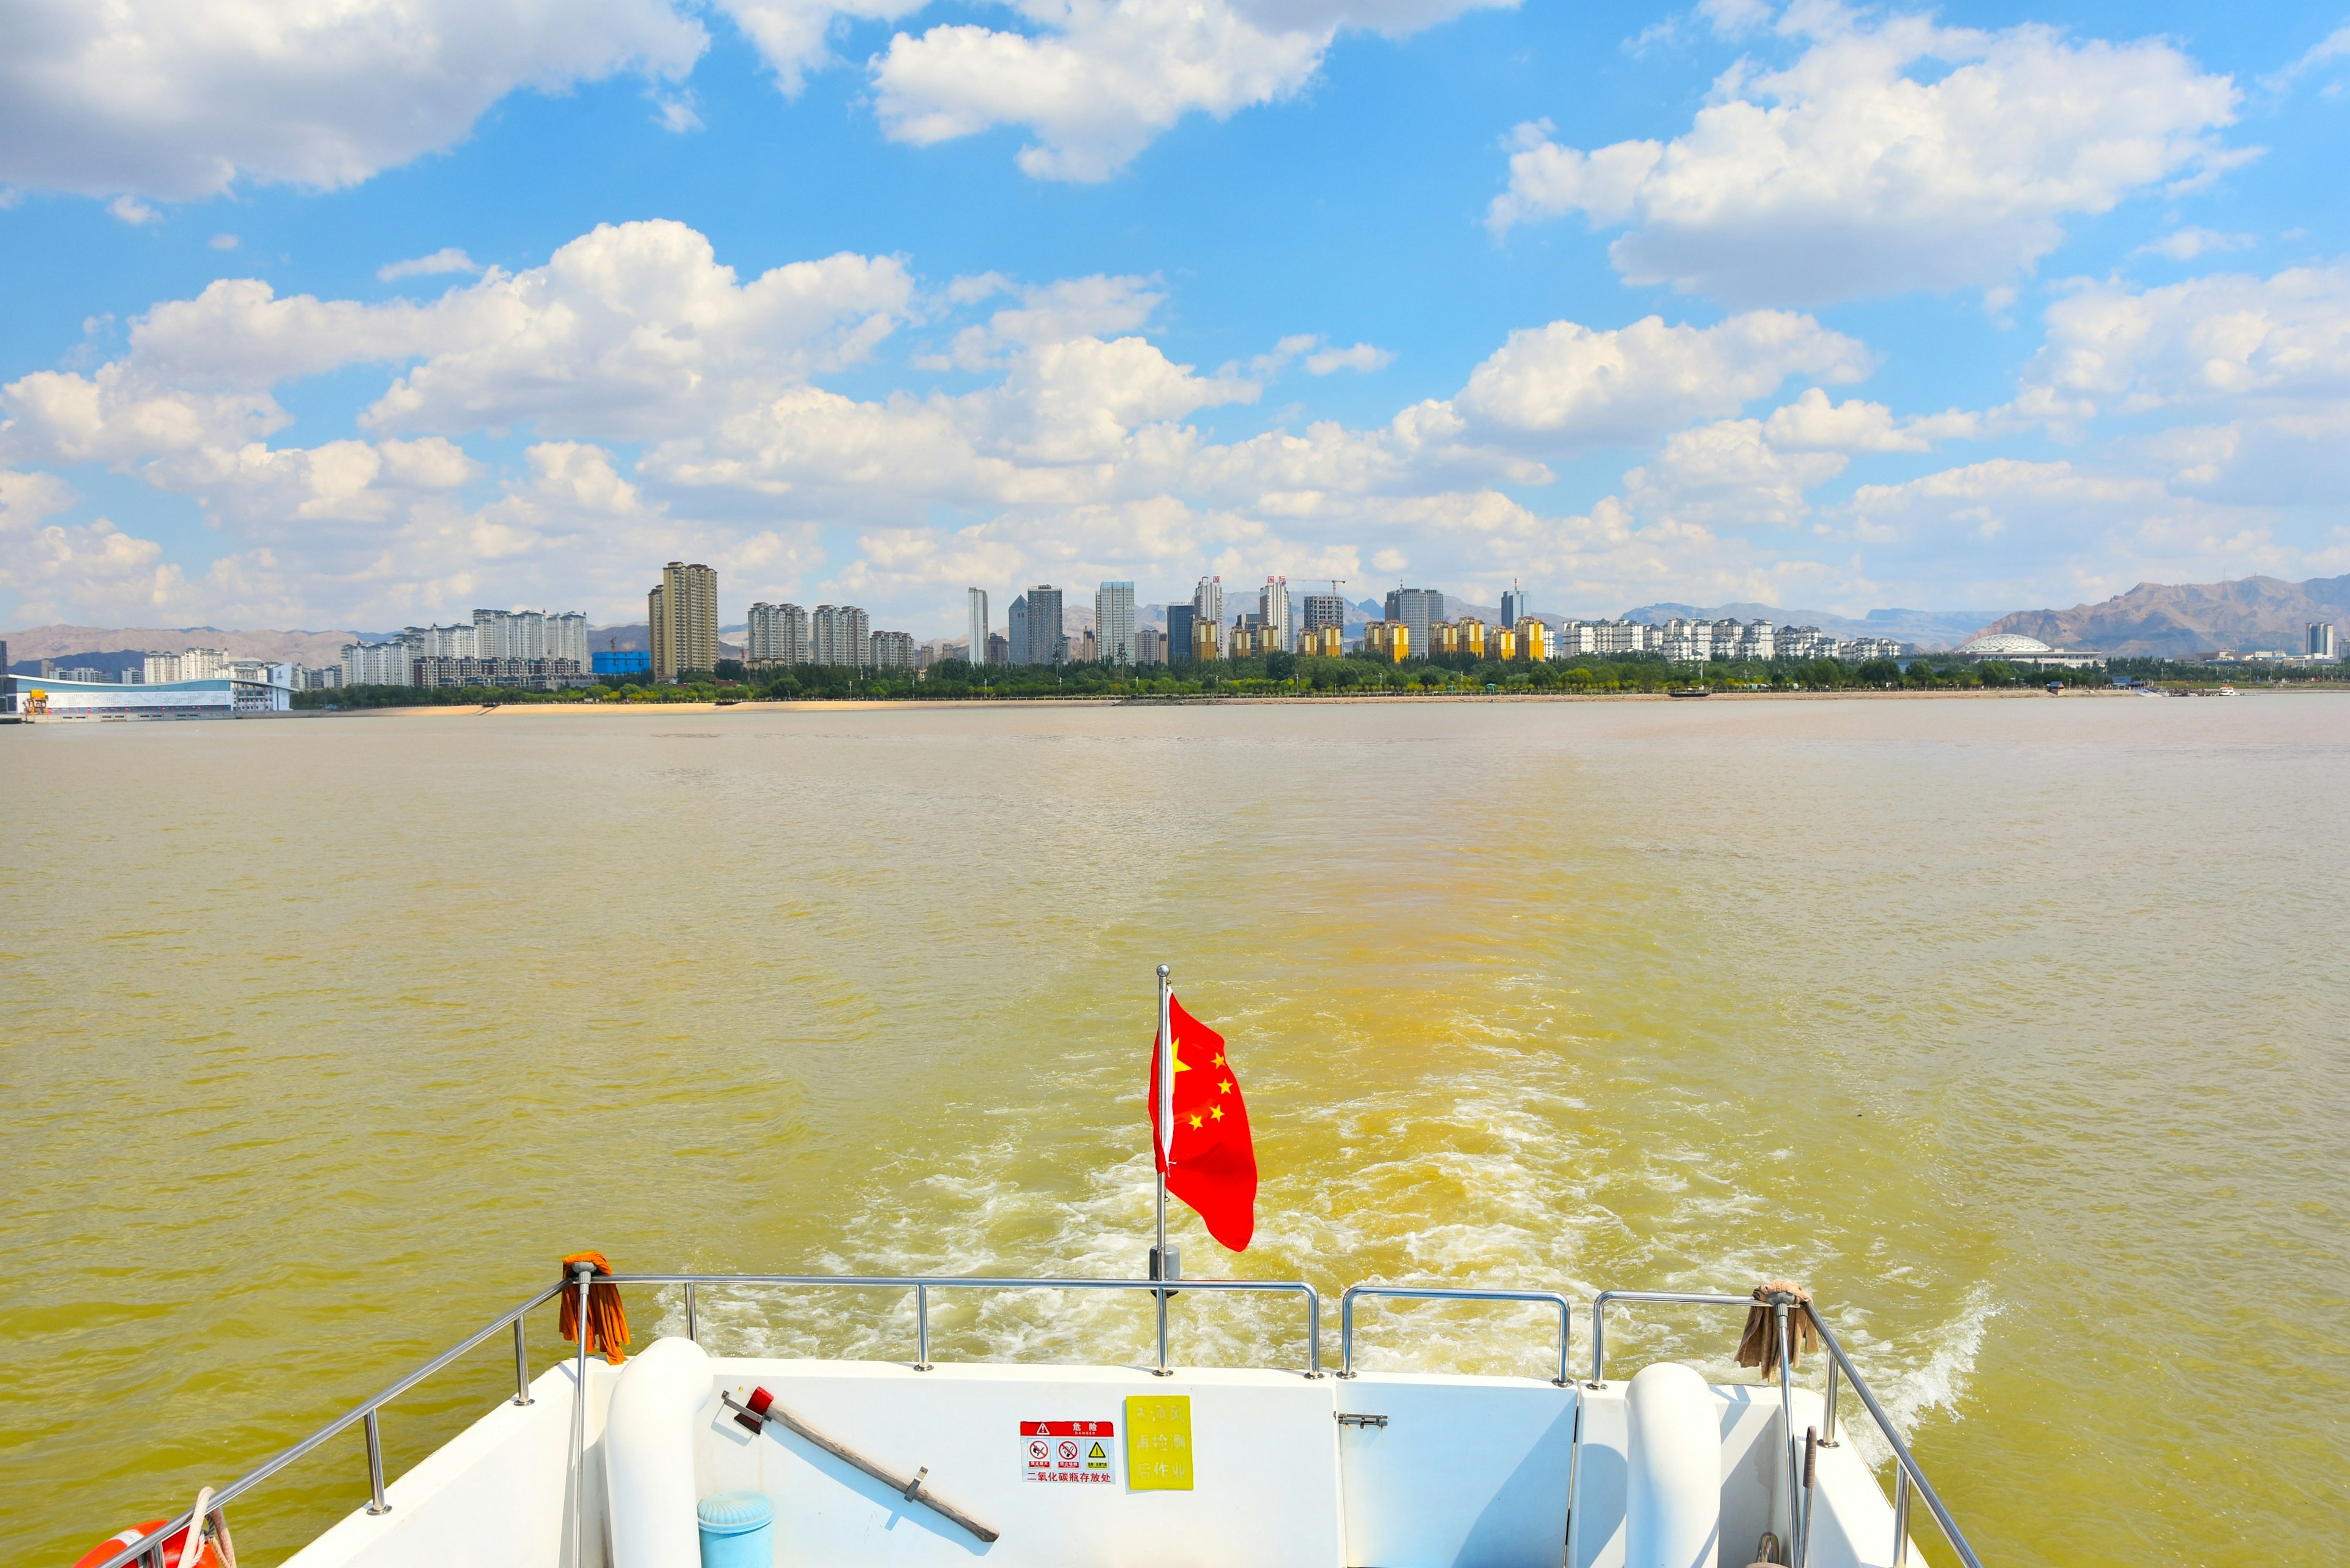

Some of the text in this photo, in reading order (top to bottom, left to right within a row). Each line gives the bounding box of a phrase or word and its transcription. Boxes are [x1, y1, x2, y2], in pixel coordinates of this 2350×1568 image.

[1073, 1422, 1097, 1431] 危险
[1138, 1462, 1186, 1479] 后作业
[1027, 1472, 1111, 1482] 二氧化碳瓶存放处
